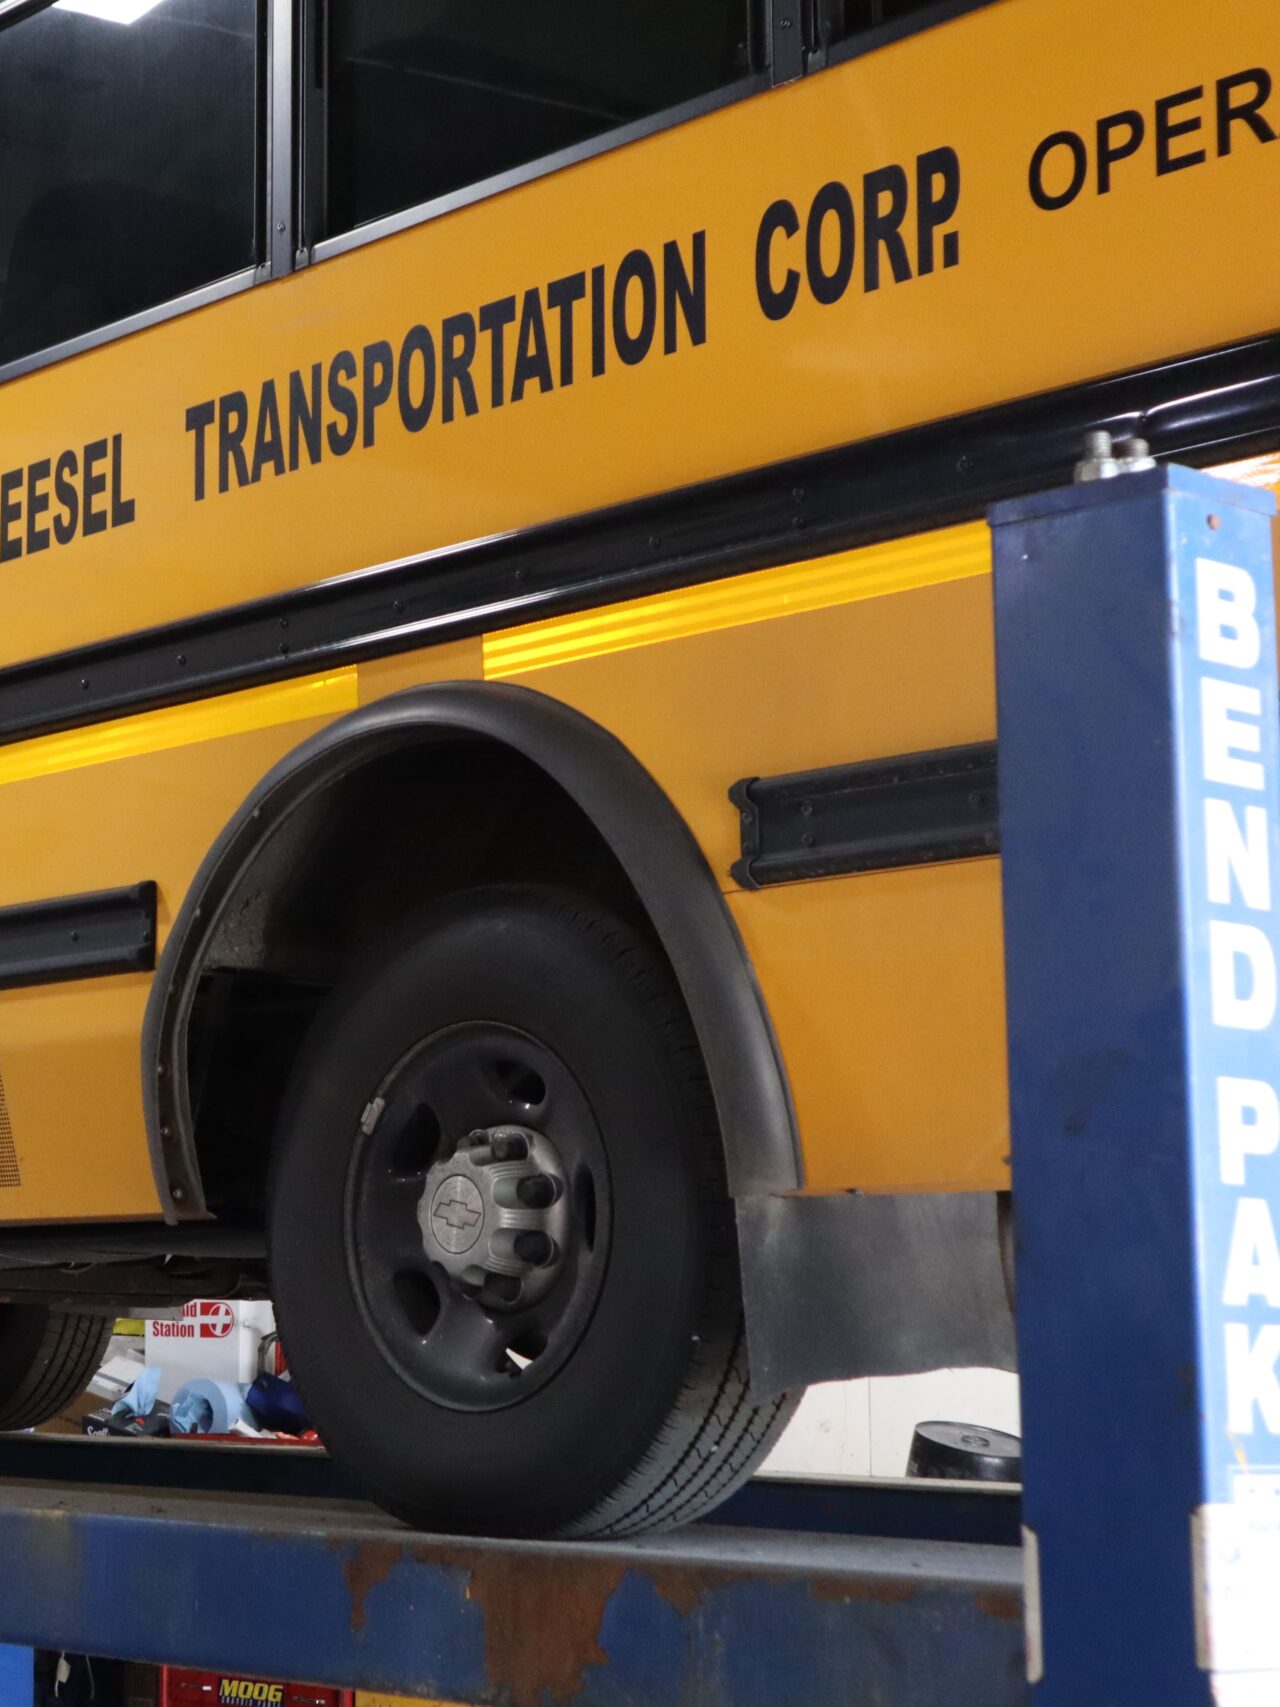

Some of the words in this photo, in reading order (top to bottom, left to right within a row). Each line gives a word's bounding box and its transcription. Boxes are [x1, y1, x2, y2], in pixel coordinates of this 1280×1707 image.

[185, 229, 707, 502] TRANSPORTATION
[755, 145, 961, 321] CORP.
[1028, 66, 1280, 211] OPER
[152, 1320, 195, 1338] Station
[219, 1678, 284, 1703] MOOG
